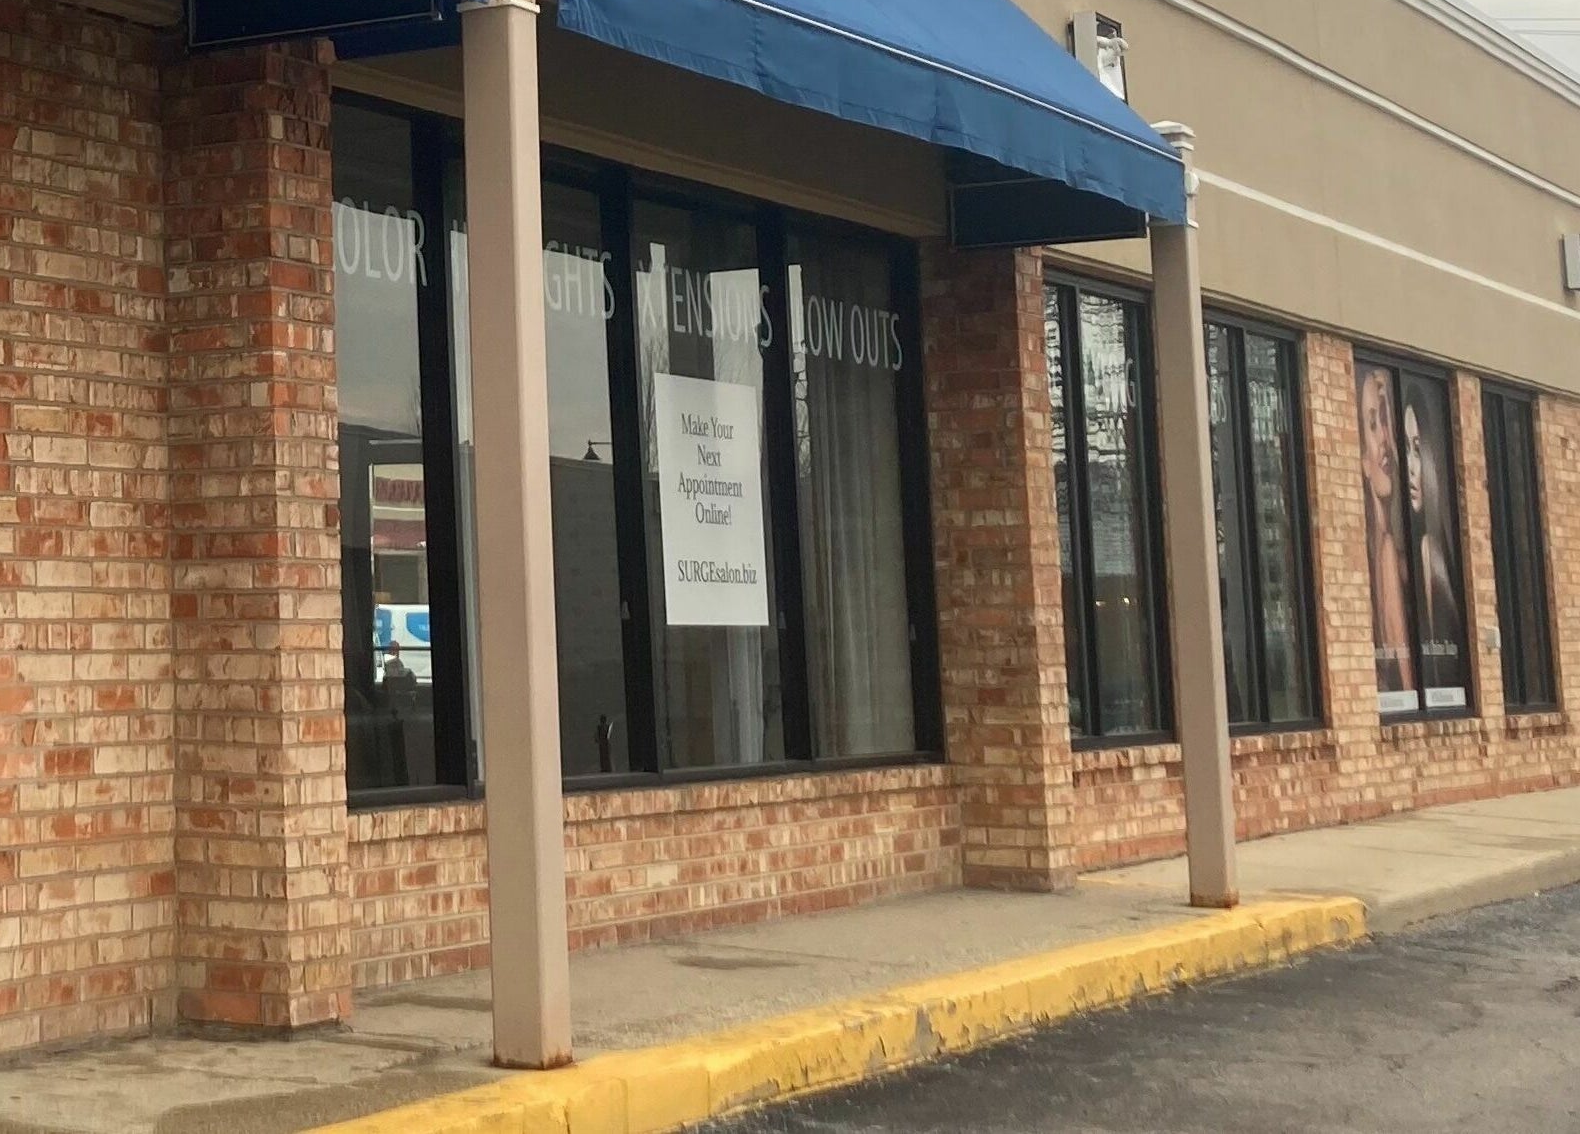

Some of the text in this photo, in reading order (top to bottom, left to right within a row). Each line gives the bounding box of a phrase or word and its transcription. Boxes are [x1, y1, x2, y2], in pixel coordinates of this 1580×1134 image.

[334, 197, 428, 287] OLOR
[543, 240, 616, 320] GHTS
[637, 259, 773, 348] XTENSIONS
[850, 304, 903, 371] OUTS
[681, 413, 734, 440] Make Your
[697, 443, 722, 467] Next
[677, 472, 743, 500] Appointment
[695, 502, 732, 526] Online!
[677, 560, 758, 585] SURGEsalon.biz
